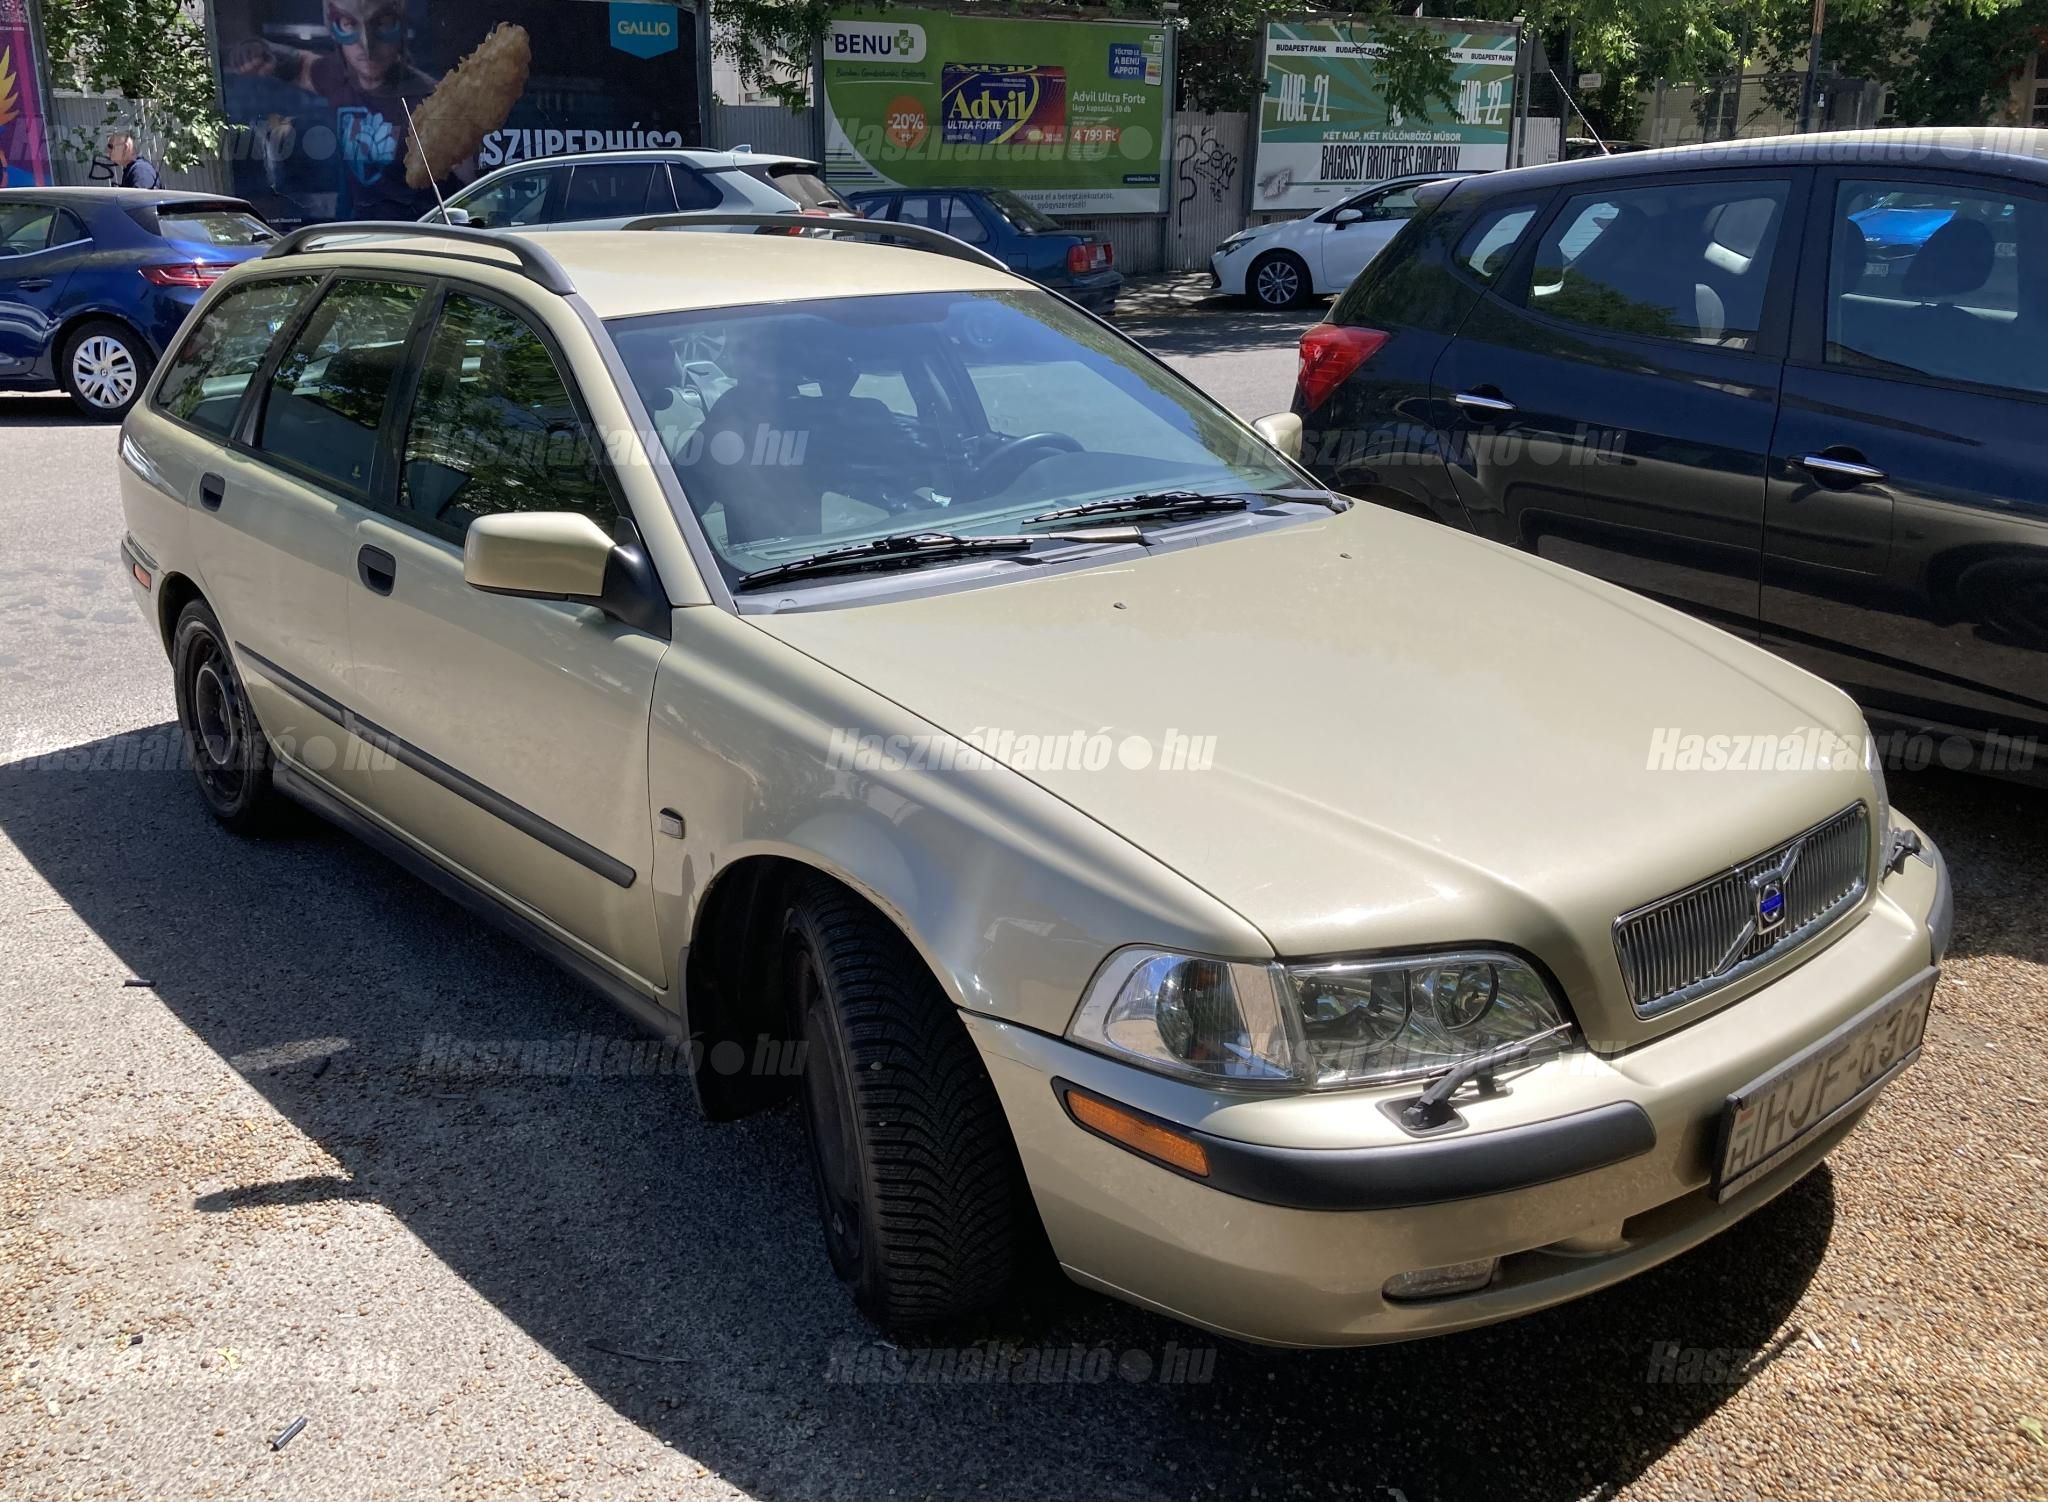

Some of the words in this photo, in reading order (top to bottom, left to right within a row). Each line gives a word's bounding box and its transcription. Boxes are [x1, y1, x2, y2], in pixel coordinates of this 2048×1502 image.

[617, 20, 671, 36] GALLIO
[834, 34, 892, 54] BENU
[1276, 43, 1309, 52] BUDAPEST
[1113, 56, 1120, 64] A
[1120, 56, 1140, 65] BENU
[1449, 51, 1464, 59] PARK
[1499, 54, 1513, 62] PARK
[1072, 91, 1096, 102] Advil
[1098, 91, 1121, 103] Ultra
[1122, 93, 1146, 104] Forte
[949, 89, 1026, 119] Advil
[947, 120, 975, 130] ULTRA
[975, 121, 1002, 130] FORTE
[1084, 129, 1103, 141] 799
[1323, 131, 1341, 140] KÉT
[1342, 131, 1361, 141] NAP,
[1363, 131, 1380, 140] KÉT
[1320, 145, 1366, 180] BAGOSSY
[1365, 145, 1415, 179] BROTHERS
[1414, 145, 1461, 173] COMPANY
[1761, 993, 1923, 1154] HJF-636
